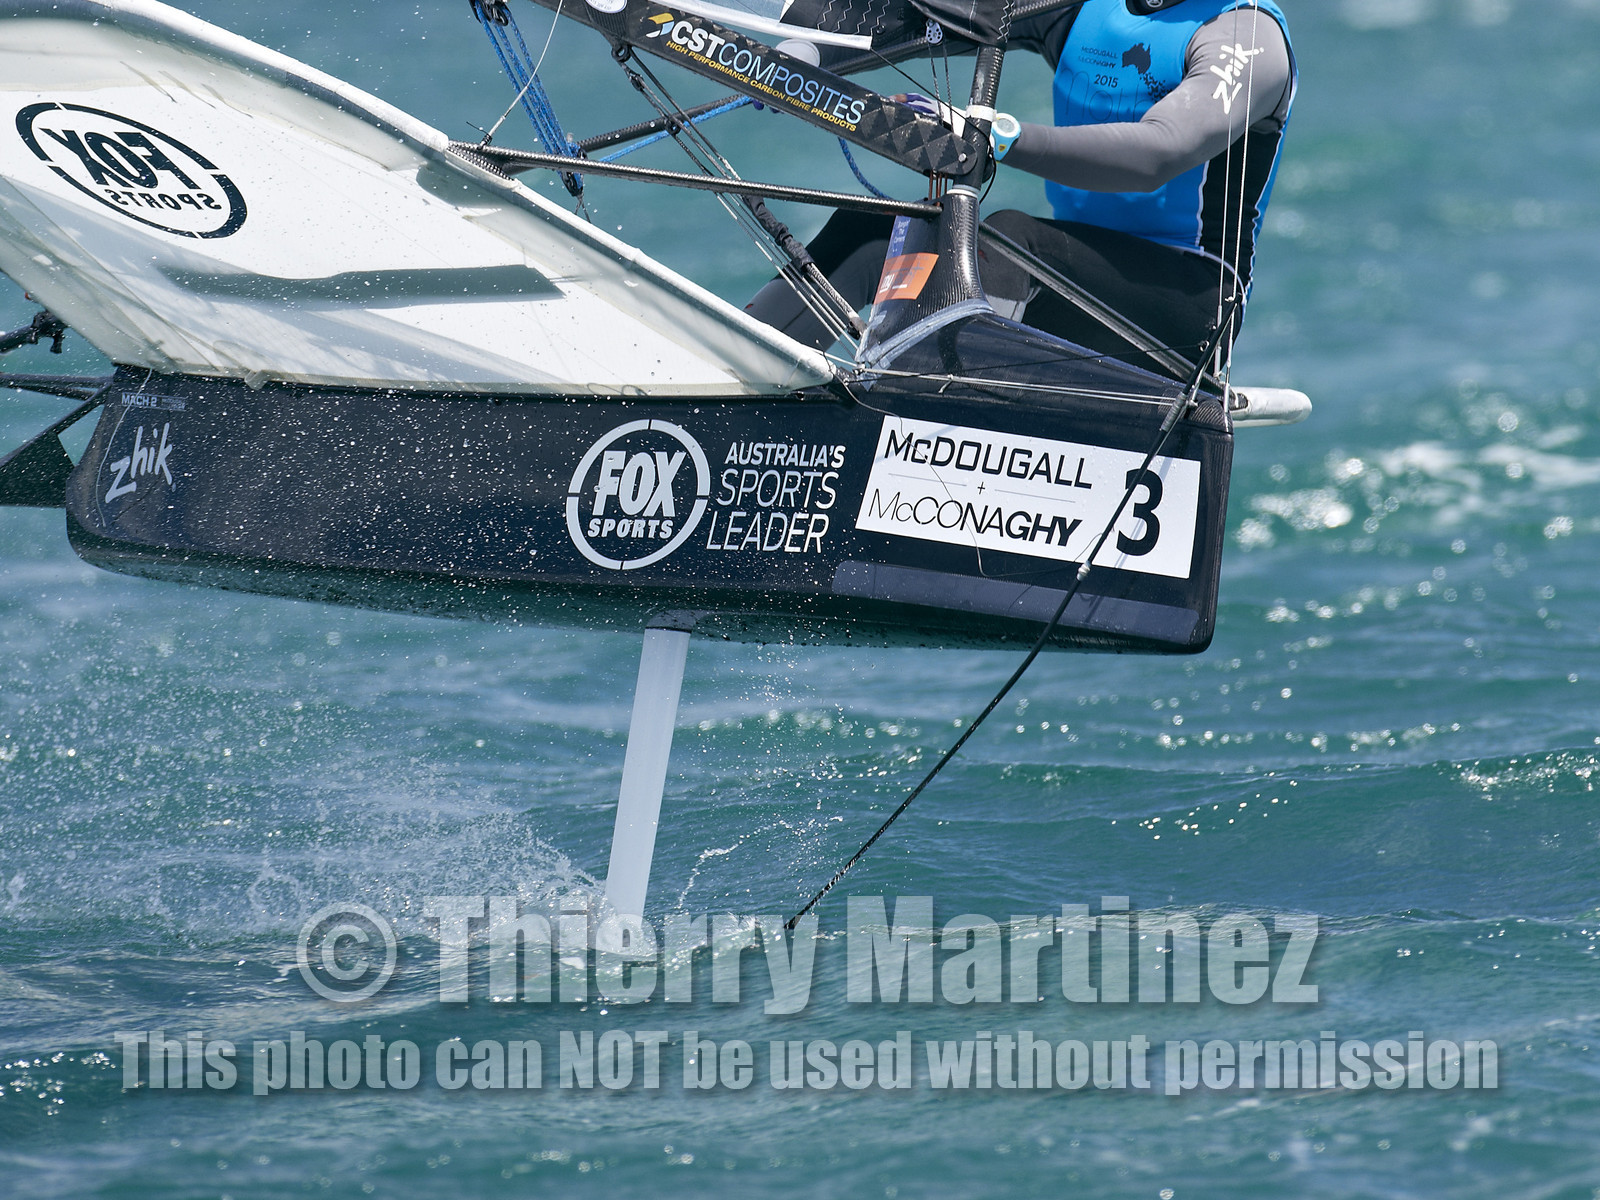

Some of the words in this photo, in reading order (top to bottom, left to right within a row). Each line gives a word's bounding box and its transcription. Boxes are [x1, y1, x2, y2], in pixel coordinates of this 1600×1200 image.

[665, 40, 689, 56] HIGH
[688, 51, 751, 85] PERFORMANCE
[750, 78, 786, 100] CARBON
[786, 95, 812, 111] FIBRE
[810, 107, 857, 132] PRODUCTS
[1094, 73, 1119, 88] 2015
[105, 423, 174, 504] zhik
[592, 449, 687, 519] FOX
[724, 441, 846, 469] AUSTRALIA'S
[884, 428, 1093, 489] McDOUGALL
[716, 469, 842, 509] SPORTS
[868, 487, 1083, 548] McCONAGHY
[1115, 467, 1165, 556] 3
[587, 517, 674, 540] SPORTS
[706, 509, 830, 554] LEADER
